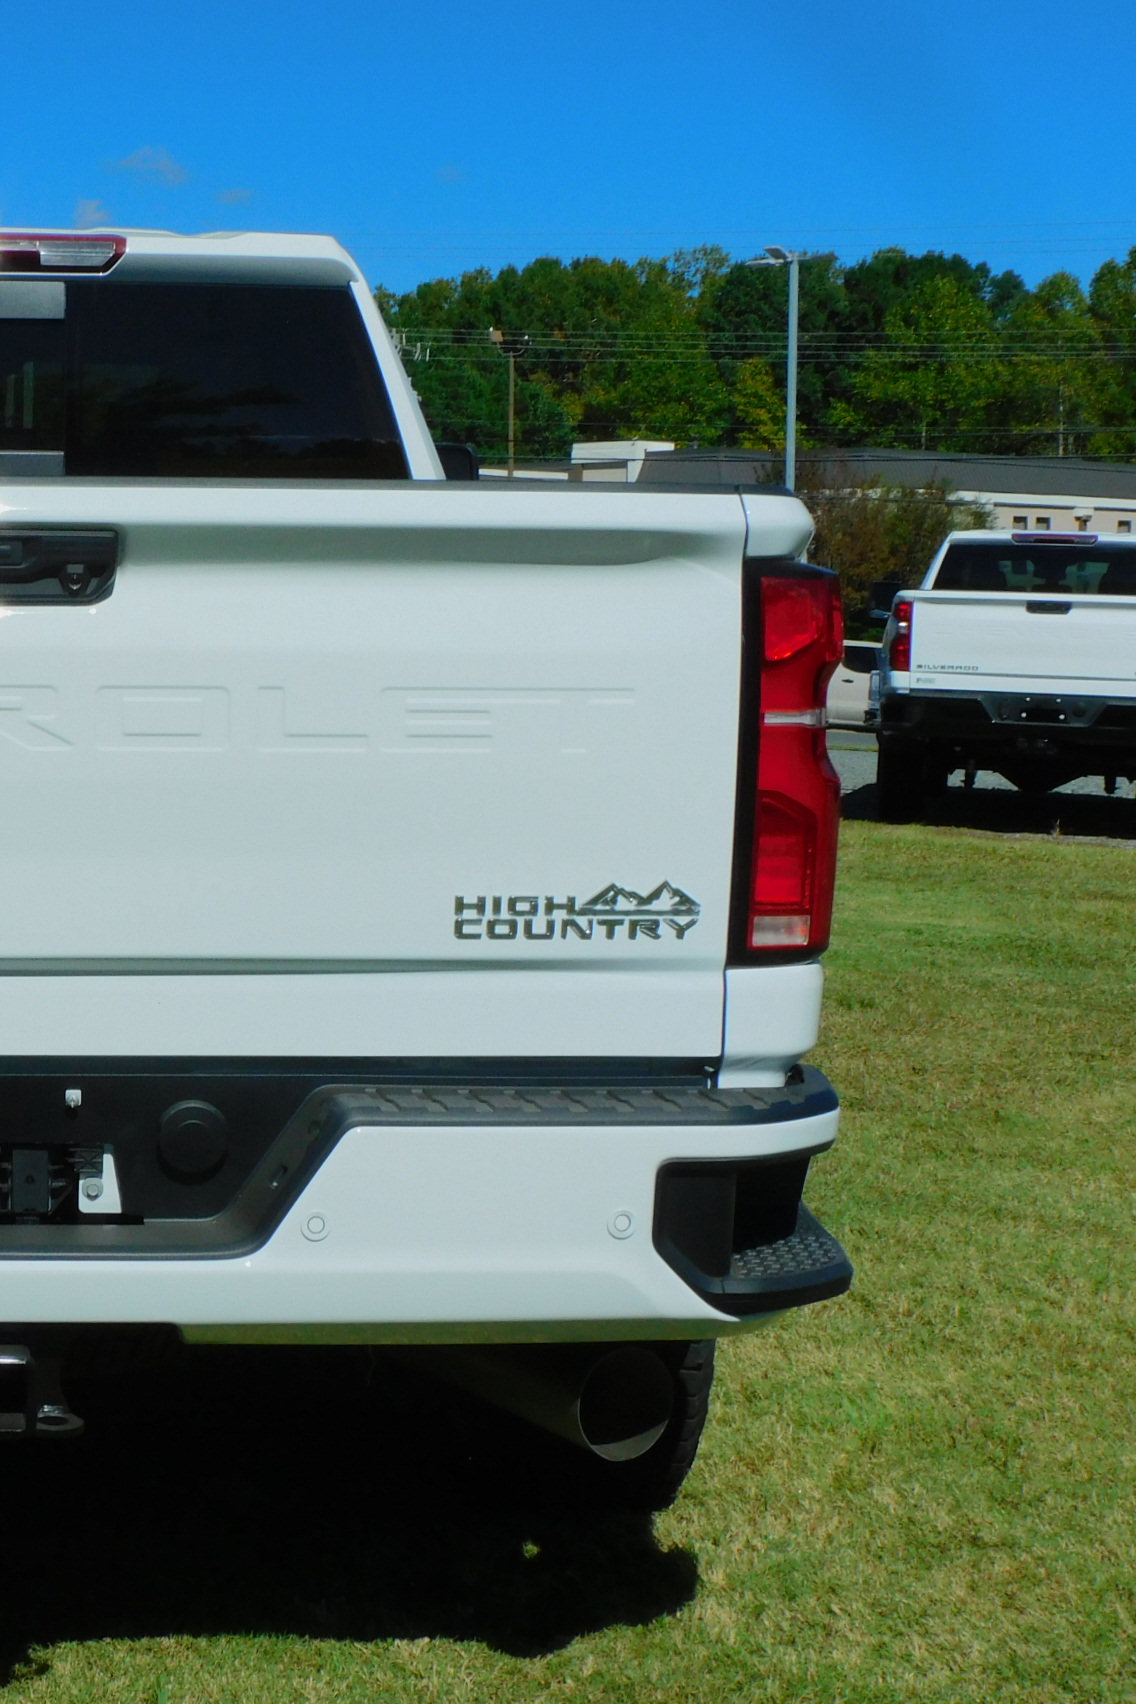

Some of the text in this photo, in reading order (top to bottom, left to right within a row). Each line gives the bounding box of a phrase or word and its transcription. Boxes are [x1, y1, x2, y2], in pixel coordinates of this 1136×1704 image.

[916, 664, 979, 672] SILVERADO
[454, 895, 577, 917] HIGH
[454, 918, 699, 941] COUNTRY
